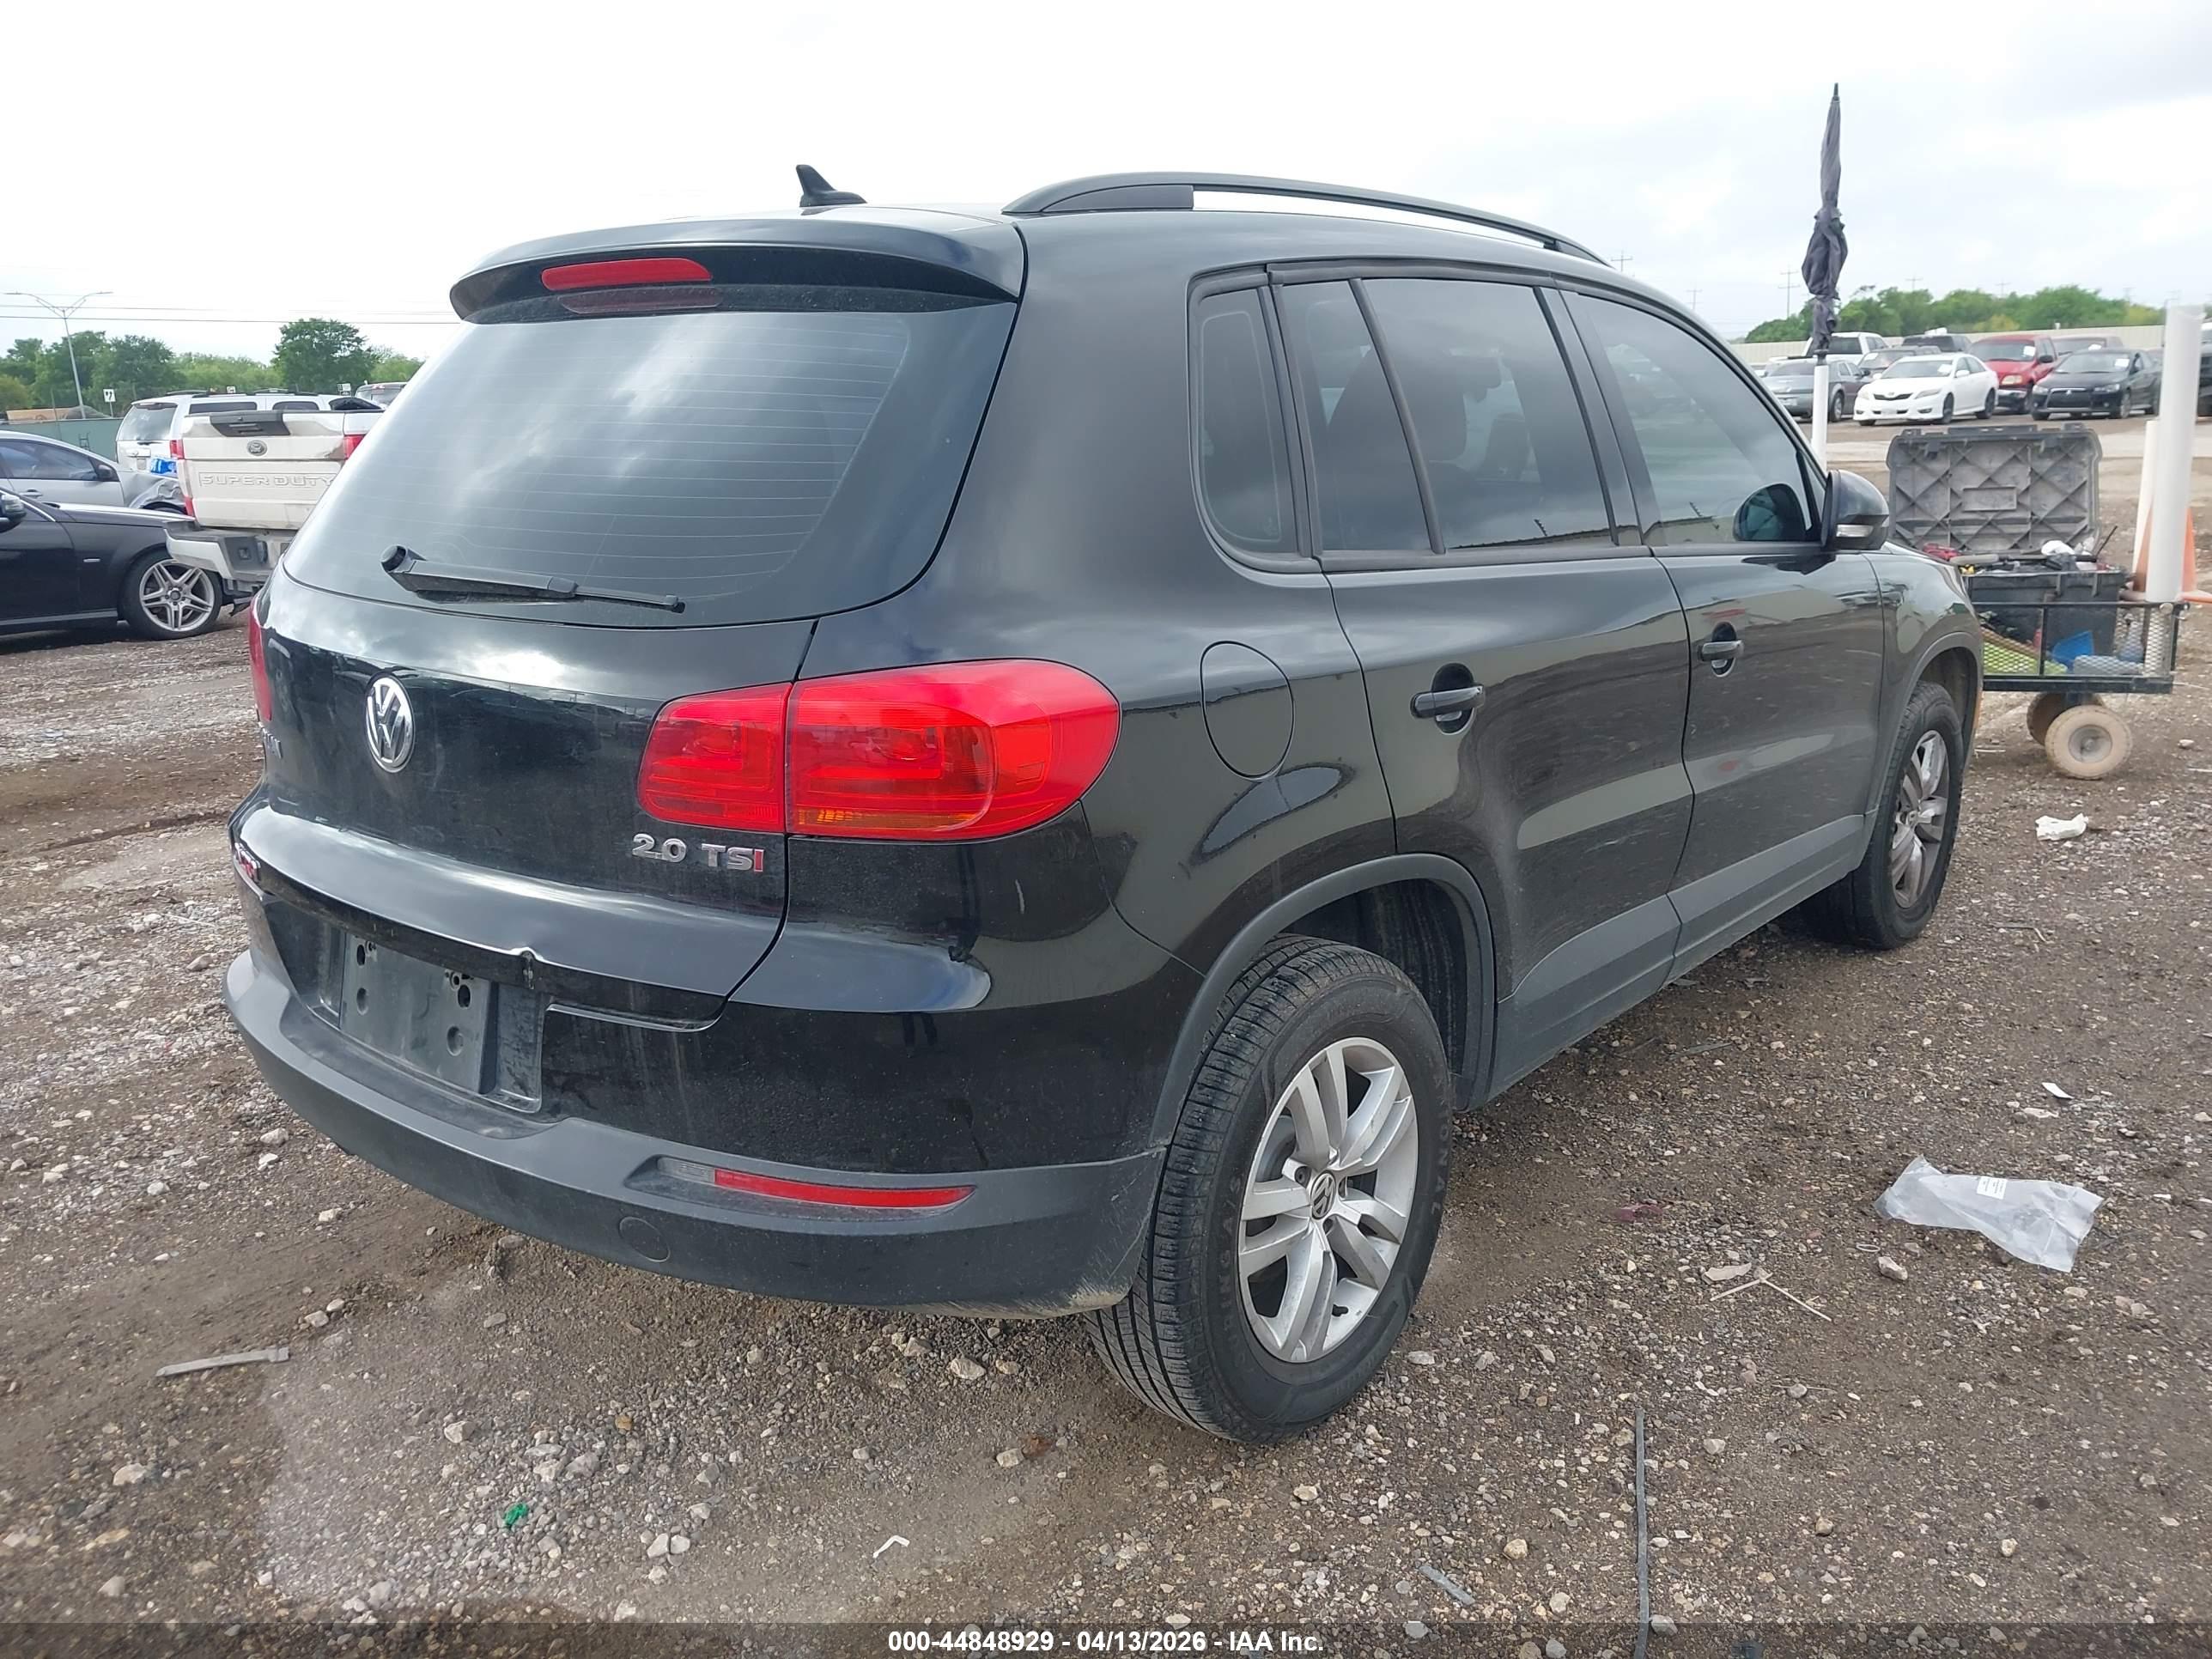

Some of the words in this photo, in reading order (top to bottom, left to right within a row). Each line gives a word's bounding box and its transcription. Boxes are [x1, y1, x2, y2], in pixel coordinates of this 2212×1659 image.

[201, 474, 270, 485] SUPER
[274, 475, 334, 487] DUTY
[367, 677, 414, 771] VW
[632, 833, 686, 862] 2.0
[701, 842, 764, 872] TSI
